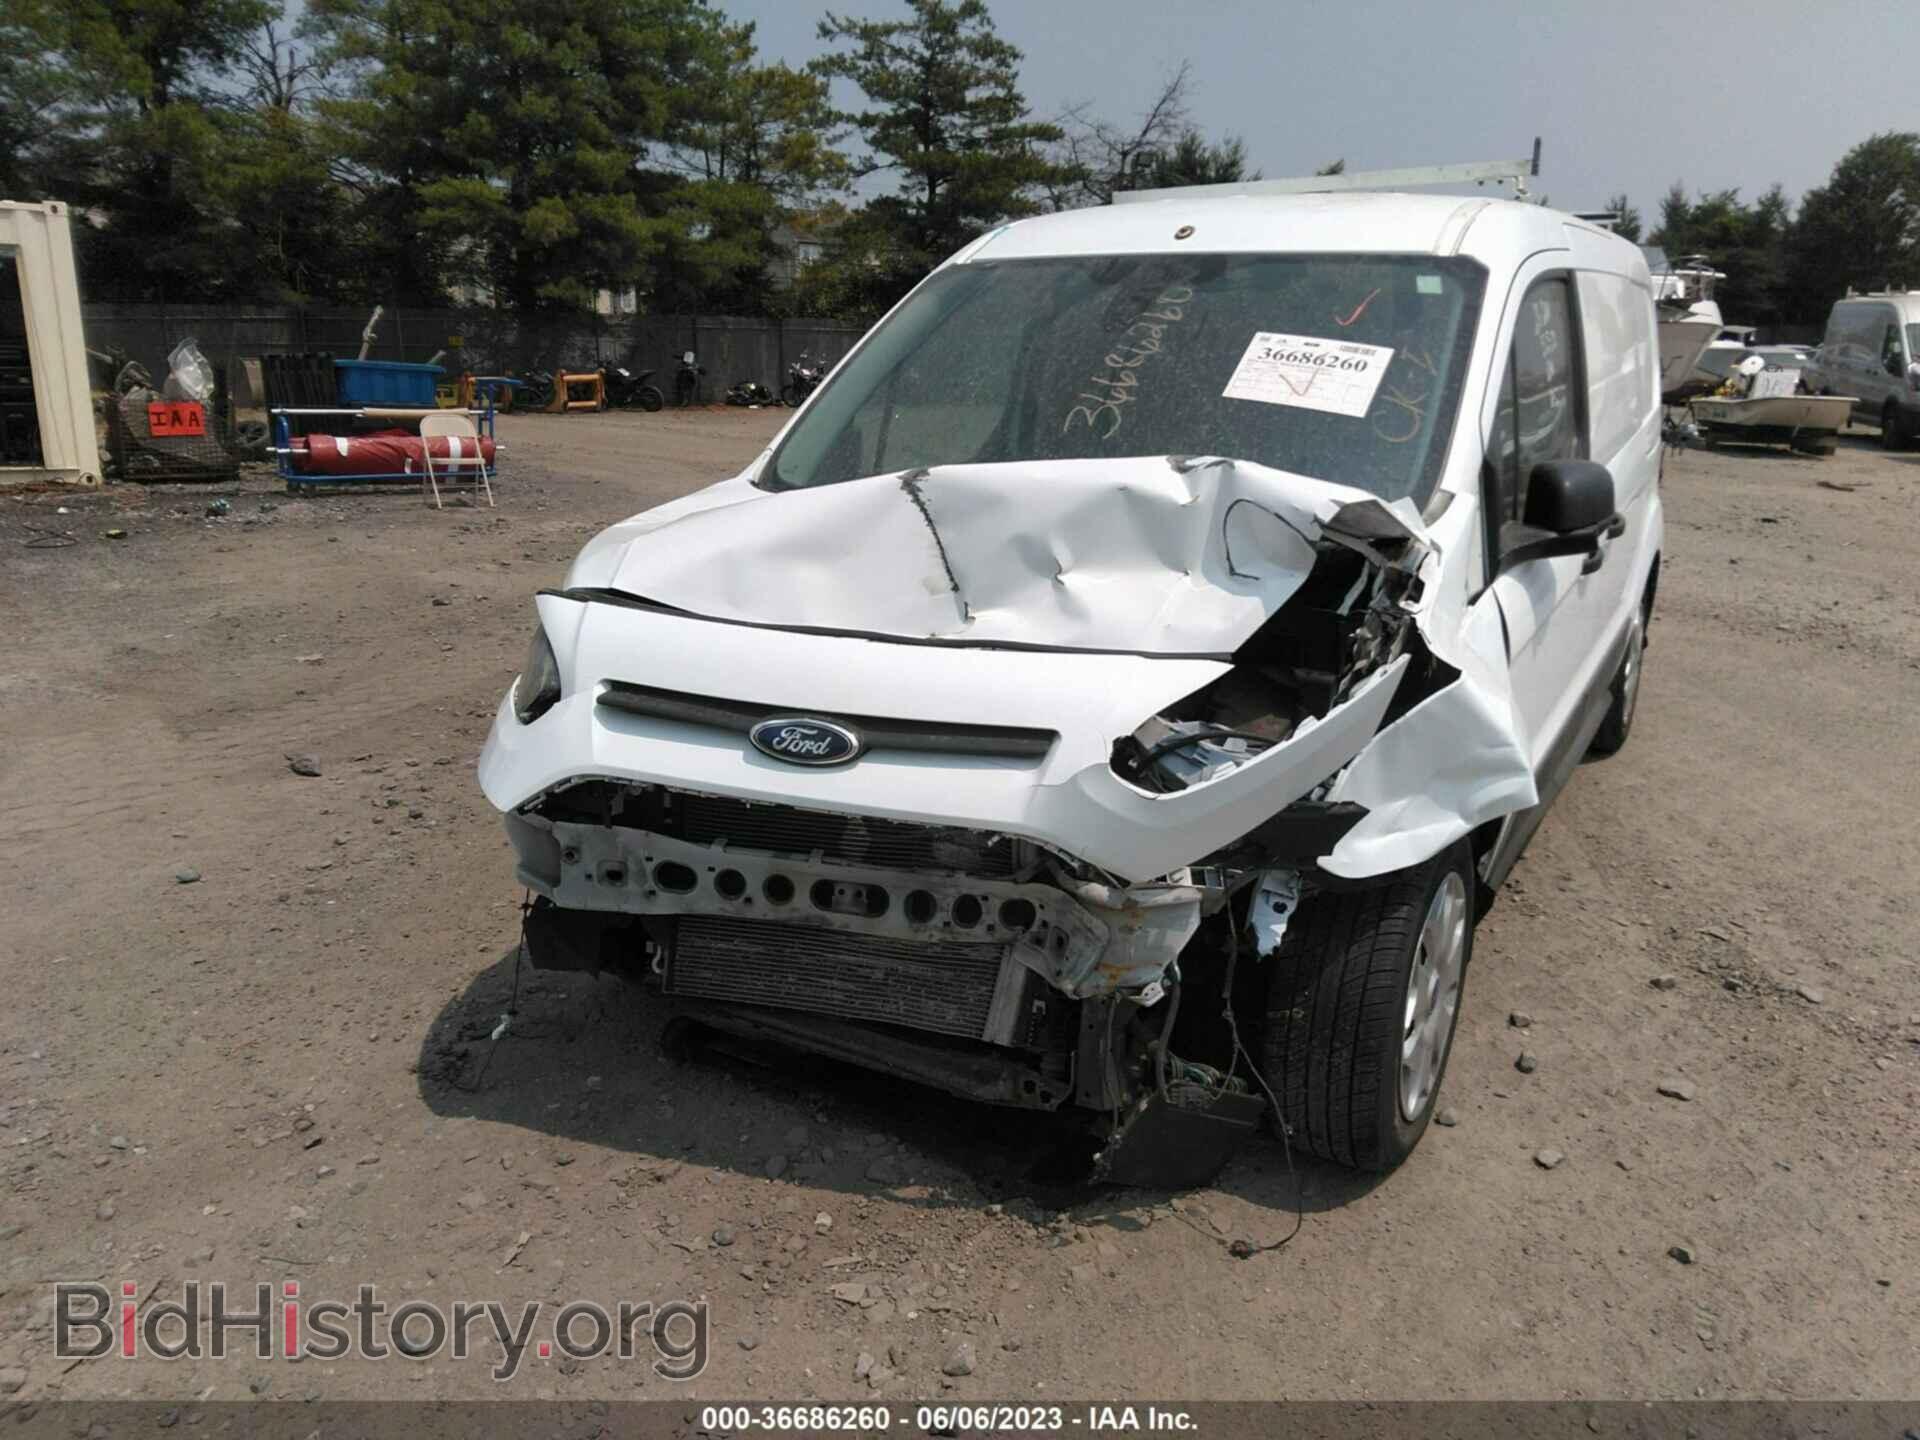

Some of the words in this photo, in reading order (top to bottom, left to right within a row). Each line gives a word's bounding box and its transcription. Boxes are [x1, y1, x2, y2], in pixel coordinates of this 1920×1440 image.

[1063, 287, 1193, 440] 36686260
[1257, 347, 1368, 373] 36686260
[151, 410, 201, 428] IAA
[772, 726, 832, 755] Ford
